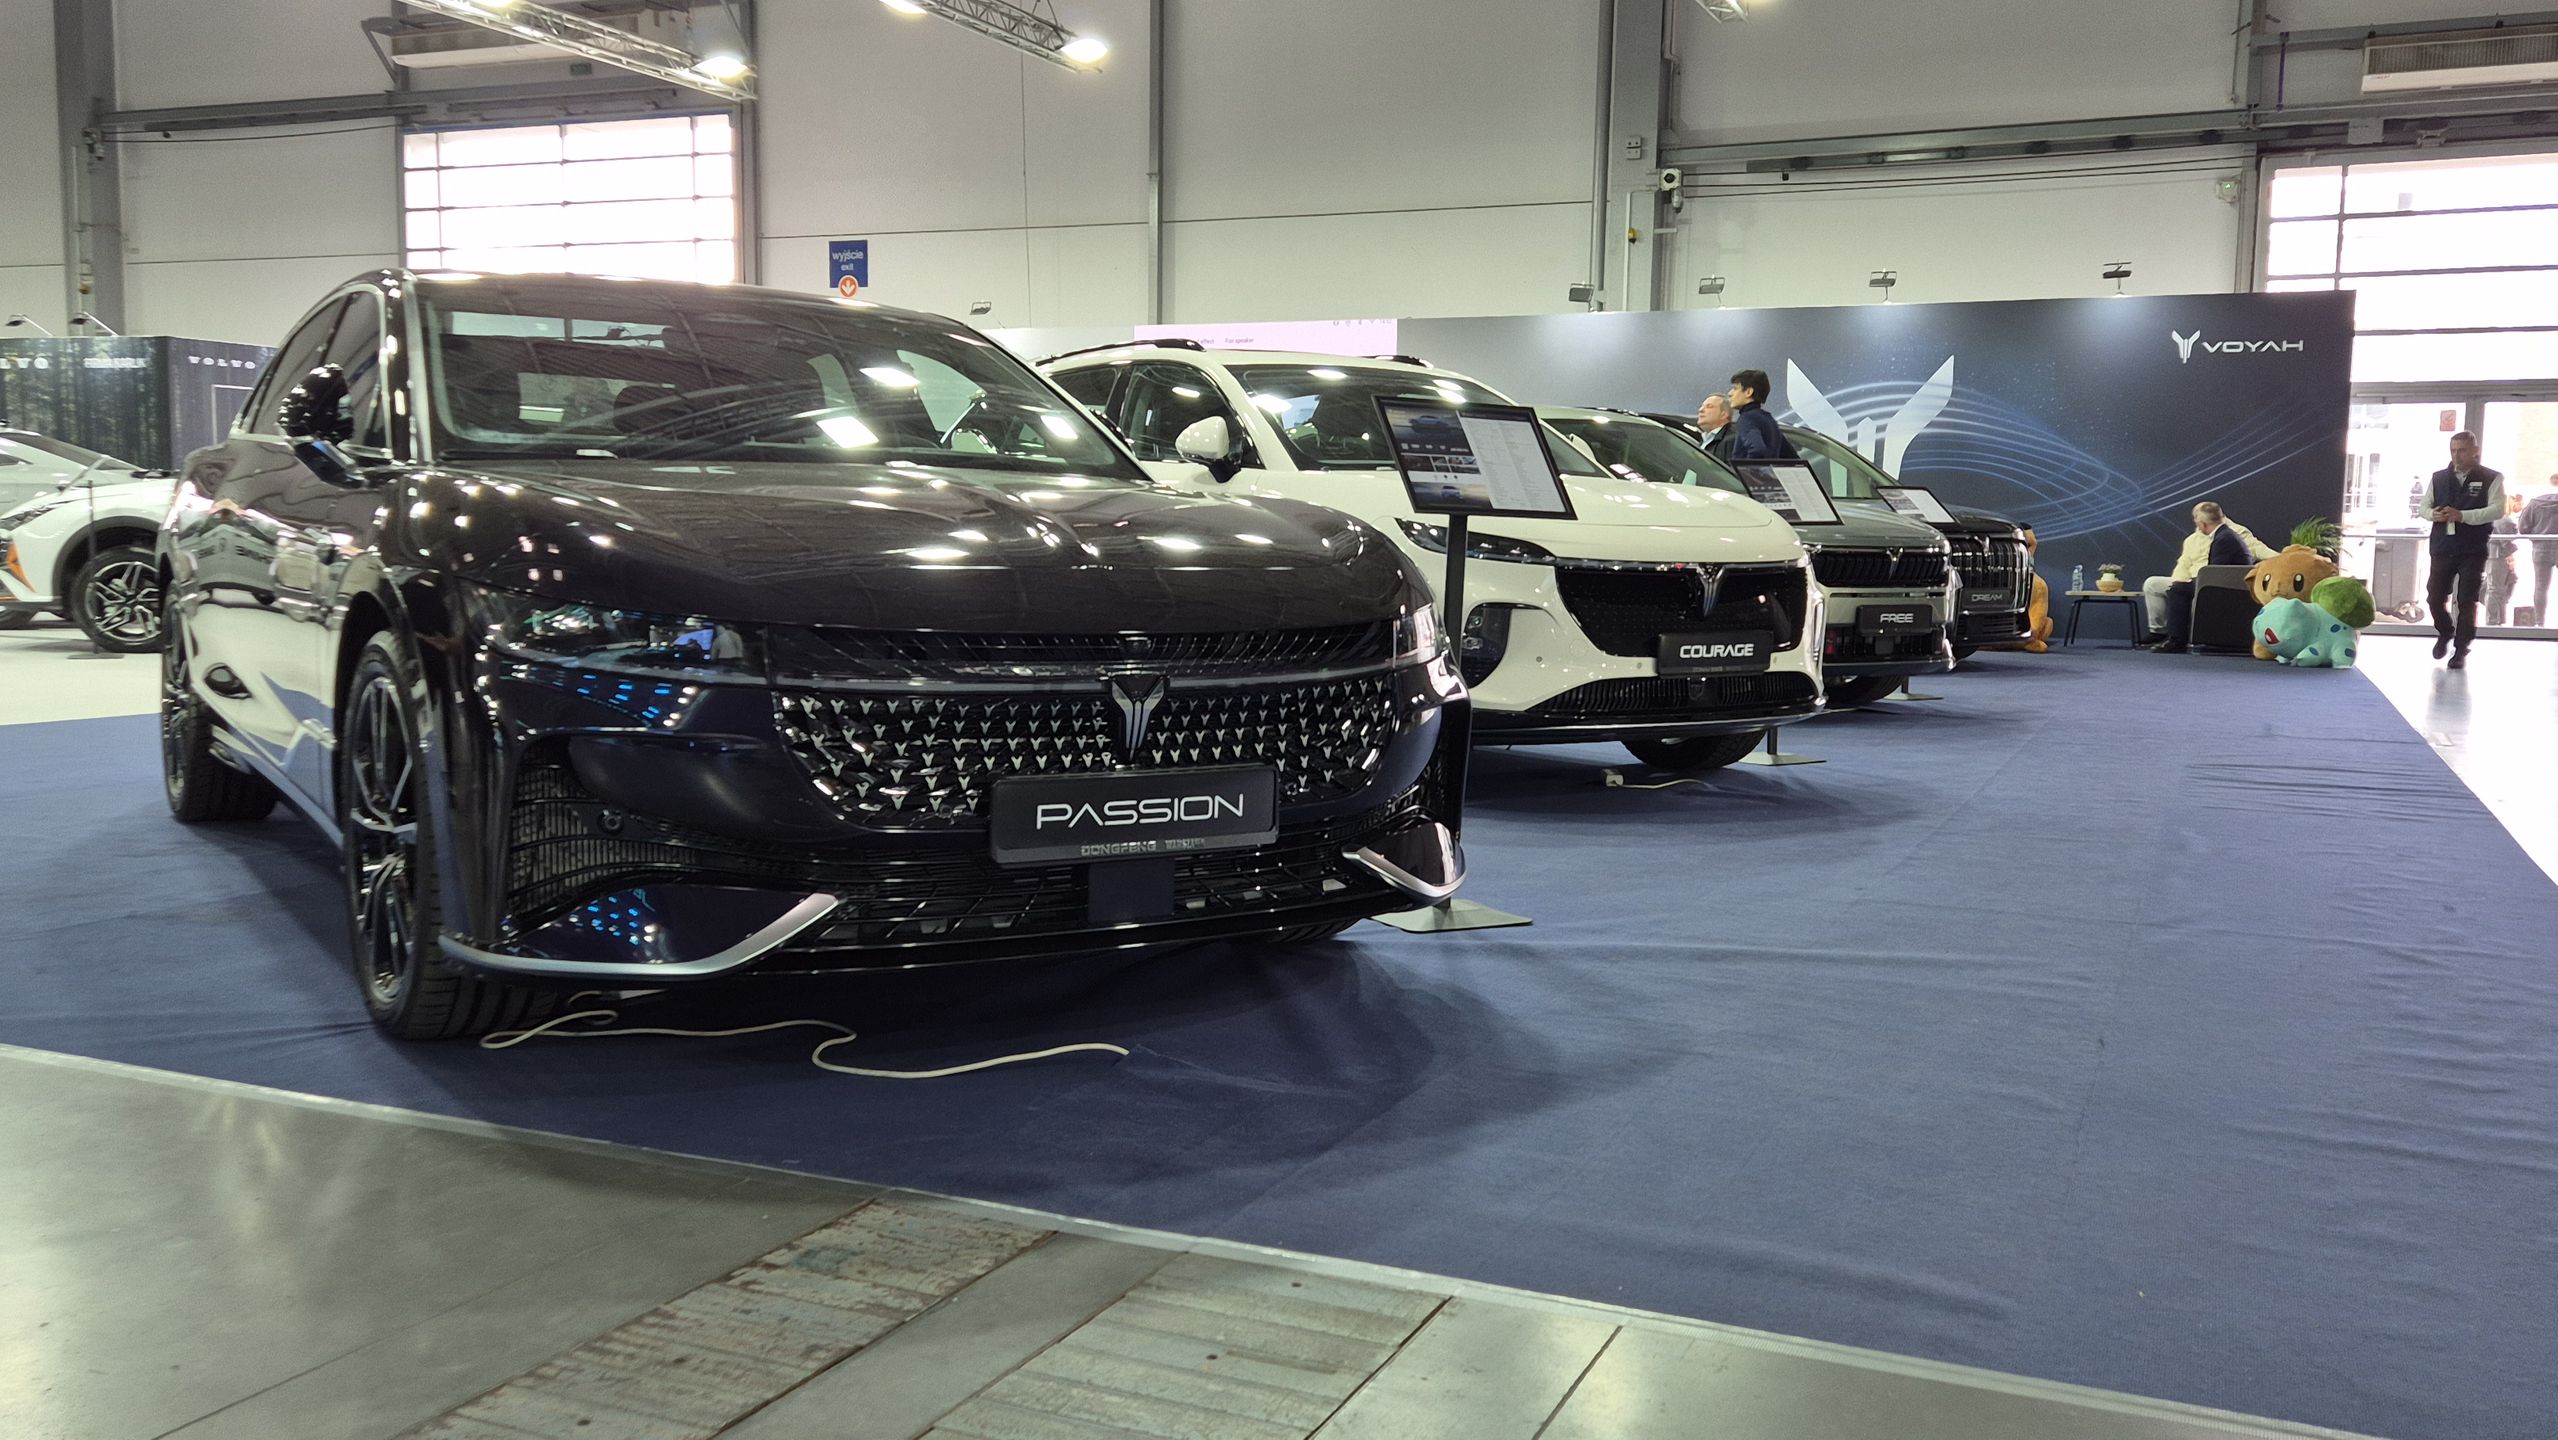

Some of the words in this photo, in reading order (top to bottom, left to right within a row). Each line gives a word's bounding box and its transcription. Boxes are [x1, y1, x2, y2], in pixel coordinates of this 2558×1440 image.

[832, 250, 864, 262] wyjście
[2202, 340, 2304, 353] VOYAH
[187, 356, 256, 369] VOLVO
[1971, 593, 2003, 602] DREAM
[1880, 613, 1914, 623] FREE
[1680, 643, 1754, 658] COURAGE
[1037, 794, 1244, 830] PASSION
[1081, 840, 1156, 856] DONGFENG
